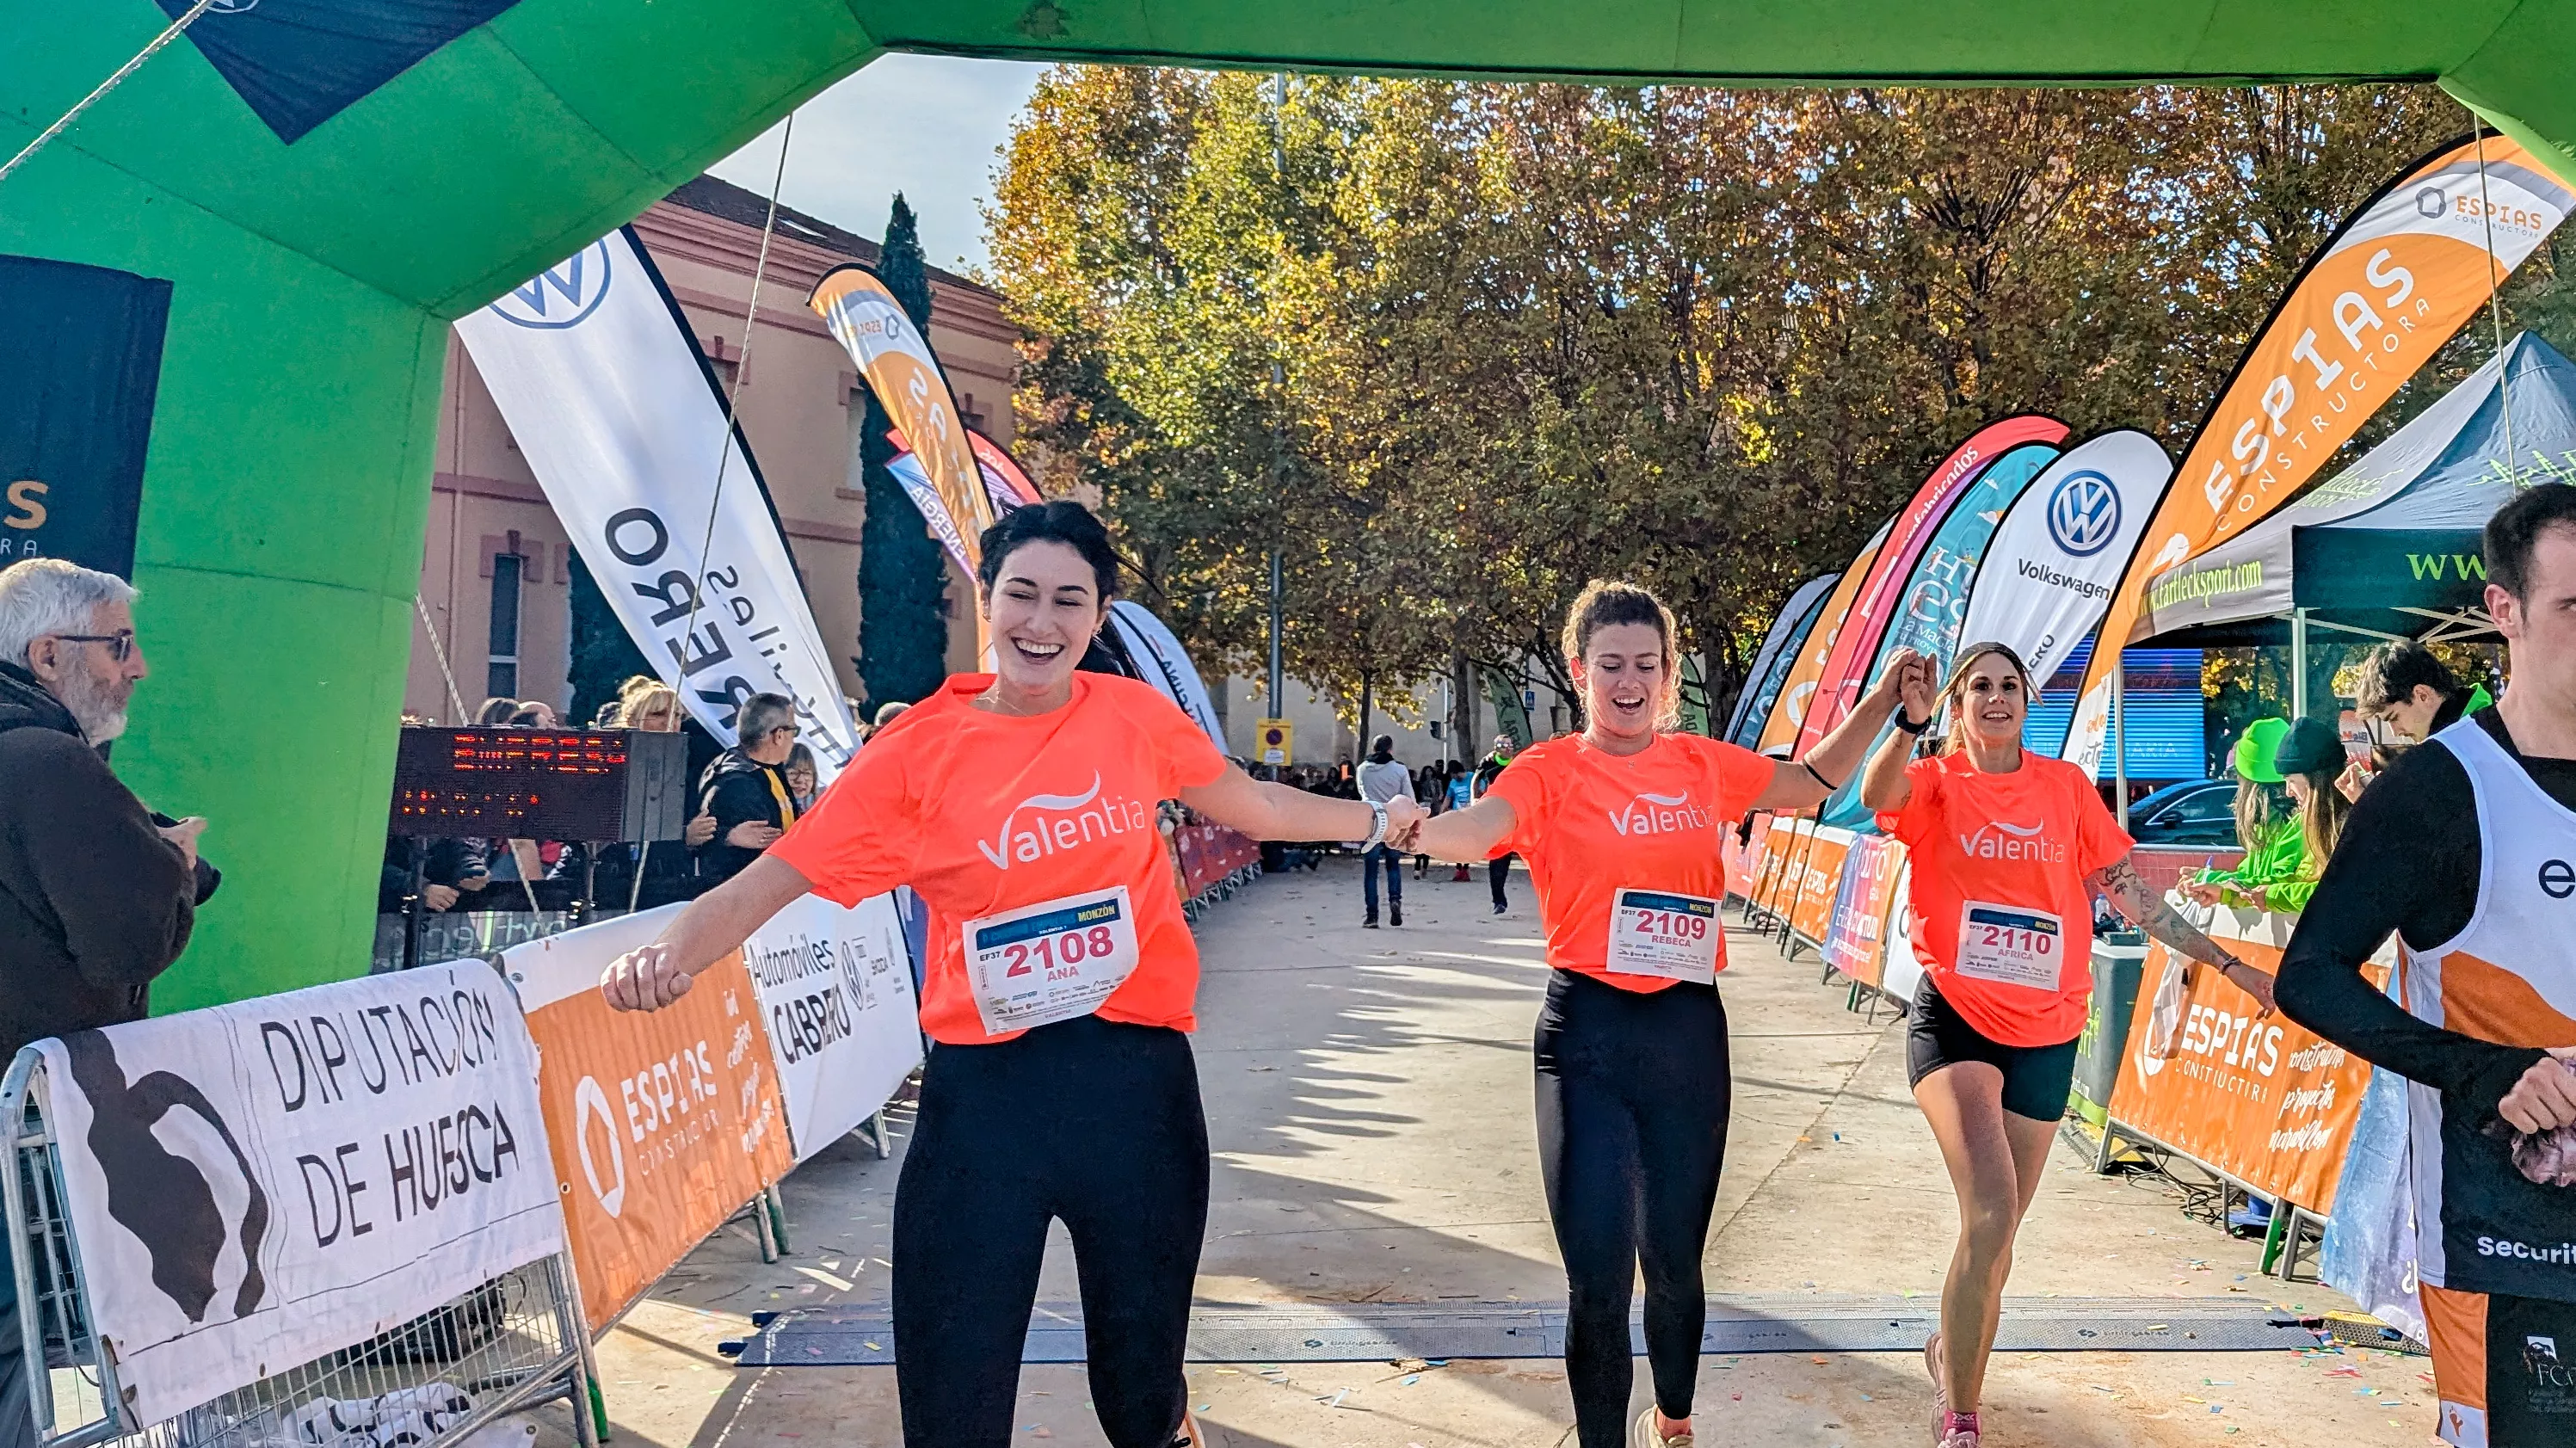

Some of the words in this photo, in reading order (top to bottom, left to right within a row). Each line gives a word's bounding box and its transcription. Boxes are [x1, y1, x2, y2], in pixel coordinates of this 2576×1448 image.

[2455, 214, 2539, 238] CONSRUCTORA
[2456, 195, 2542, 230] ESPIAS
[2203, 248, 2414, 514] ESPIAS
[2215, 298, 2430, 532] CONSTRUCTORA
[2018, 558, 2111, 601] Volkswagen
[977, 768, 1145, 870] Valentia
[1960, 816, 2065, 863] Valentia
[1077, 903, 1116, 922] MONZÓN
[1636, 909, 1706, 940] 2109
[749, 933, 835, 989] Automóviles
[1004, 926, 1114, 978] 2108
[1651, 934, 1692, 947] REBECA
[1982, 925, 2051, 955] 2110
[1997, 948, 2034, 961] AFRICA
[1047, 965, 1080, 983] ANA
[260, 970, 498, 1112] DIPUTACIÓN
[2181, 1003, 2284, 1077] ESPIAS
[619, 1039, 718, 1143] ESPIAS
[384, 1099, 521, 1222] HUESCA
[295, 1142, 373, 1248] DE
